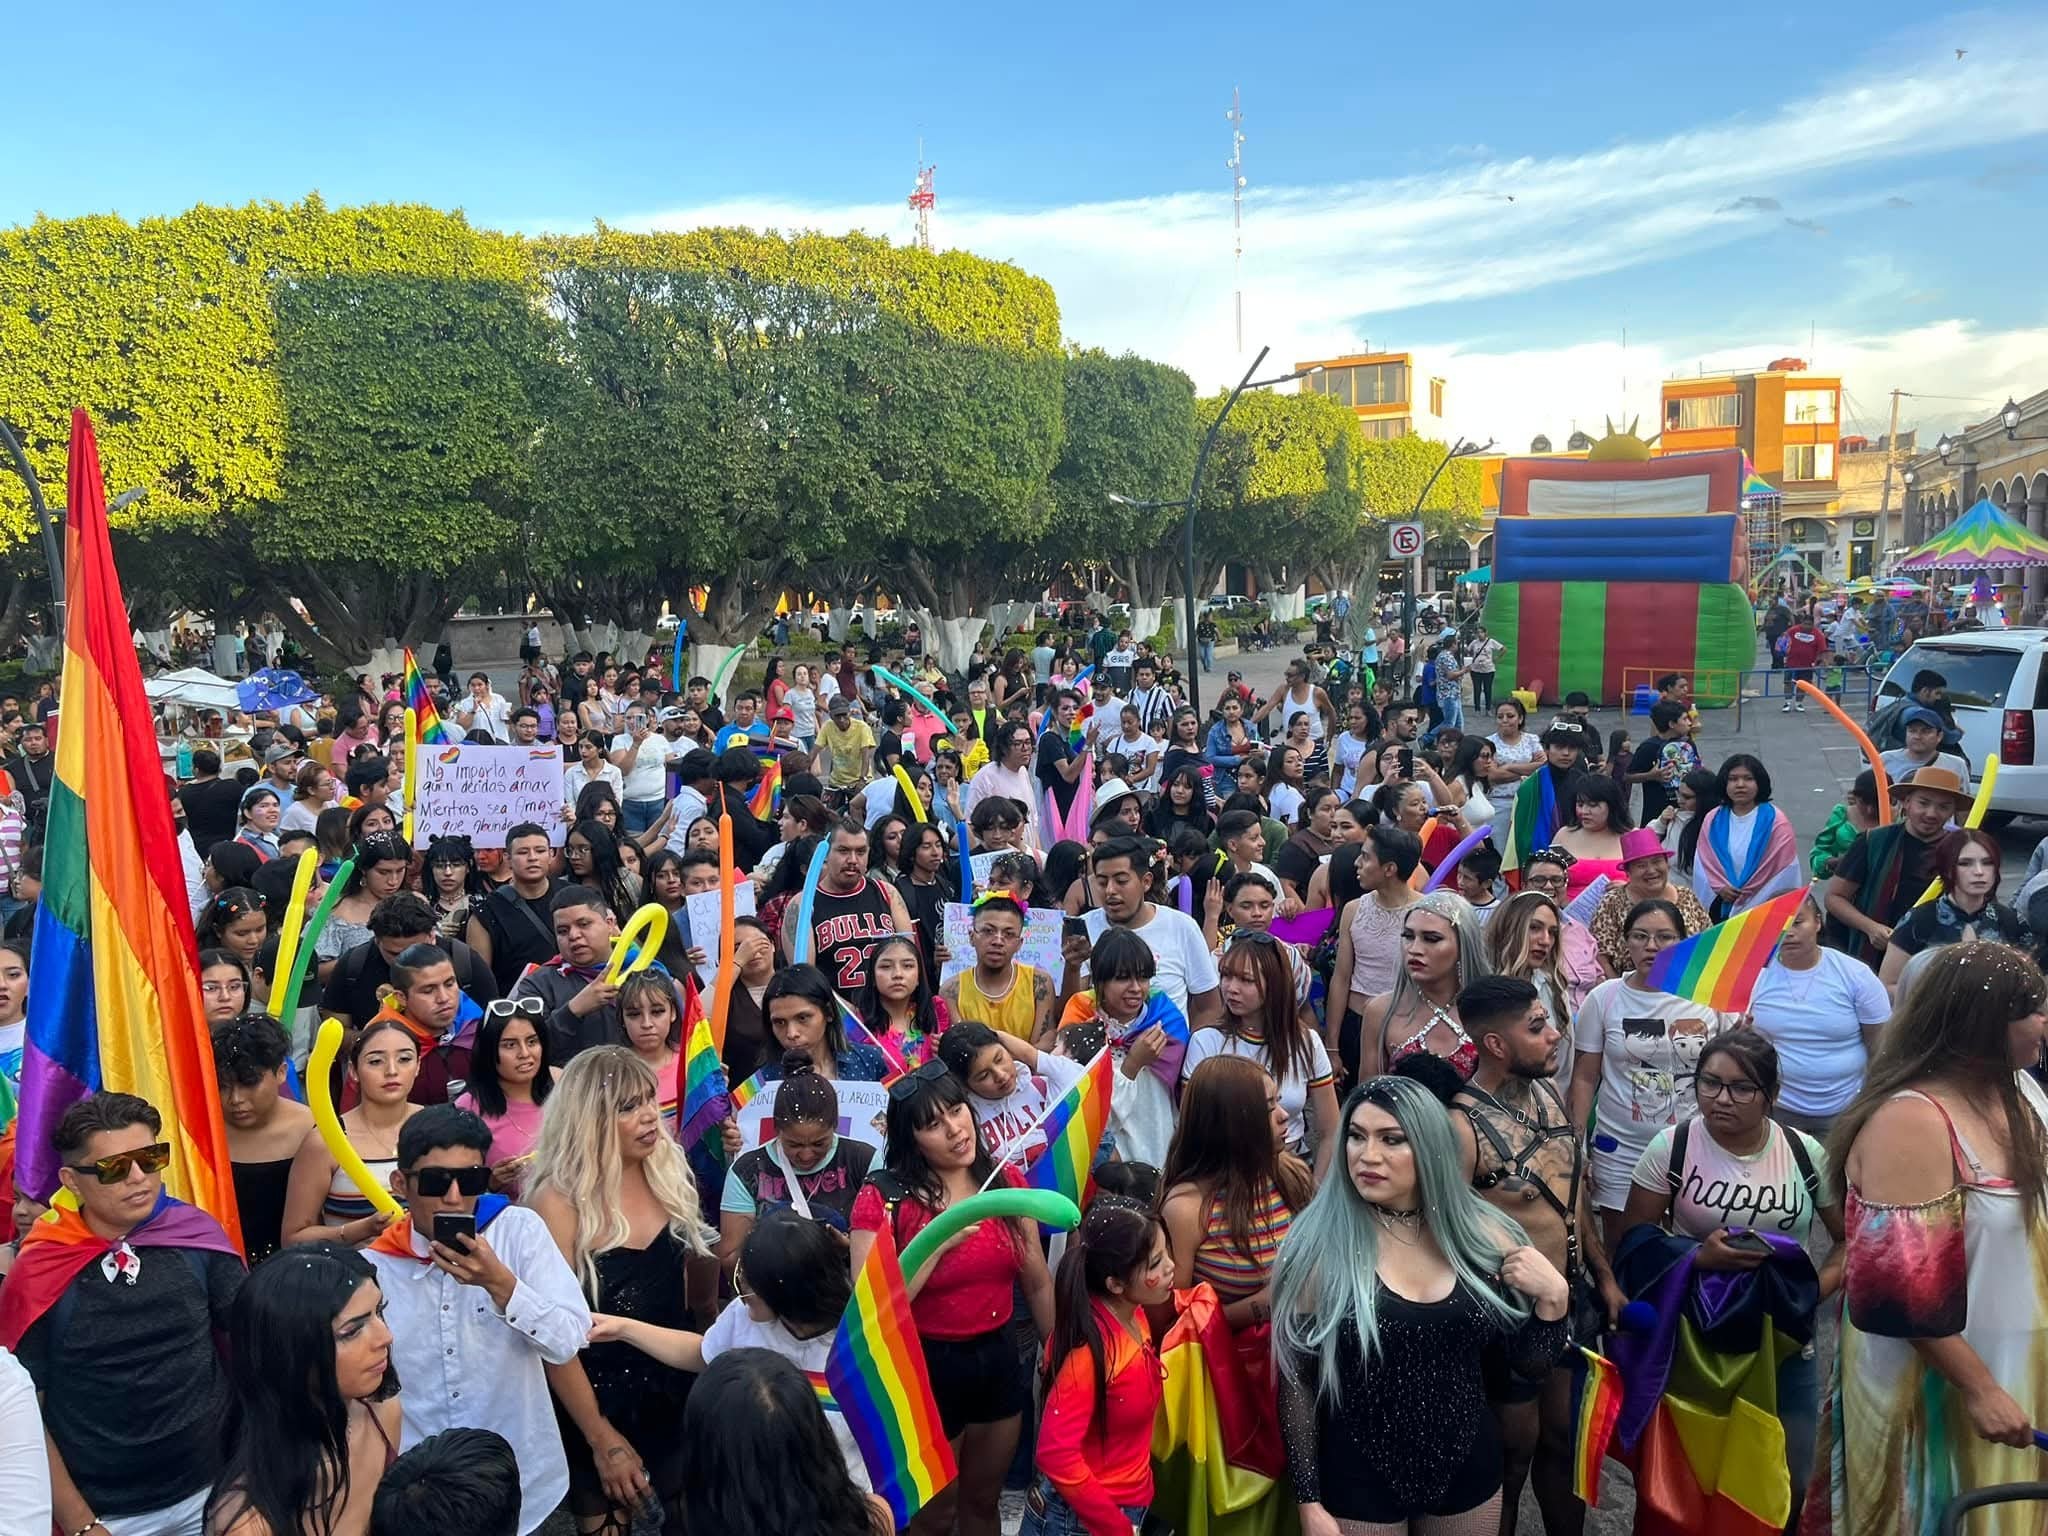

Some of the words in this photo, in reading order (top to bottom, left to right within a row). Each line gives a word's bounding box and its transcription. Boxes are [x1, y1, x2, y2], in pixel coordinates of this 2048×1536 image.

[1399, 531, 1412, 549] E
[515, 765, 525, 779] a
[816, 912, 895, 953] BULLS
[1682, 1165, 1804, 1230] happy
